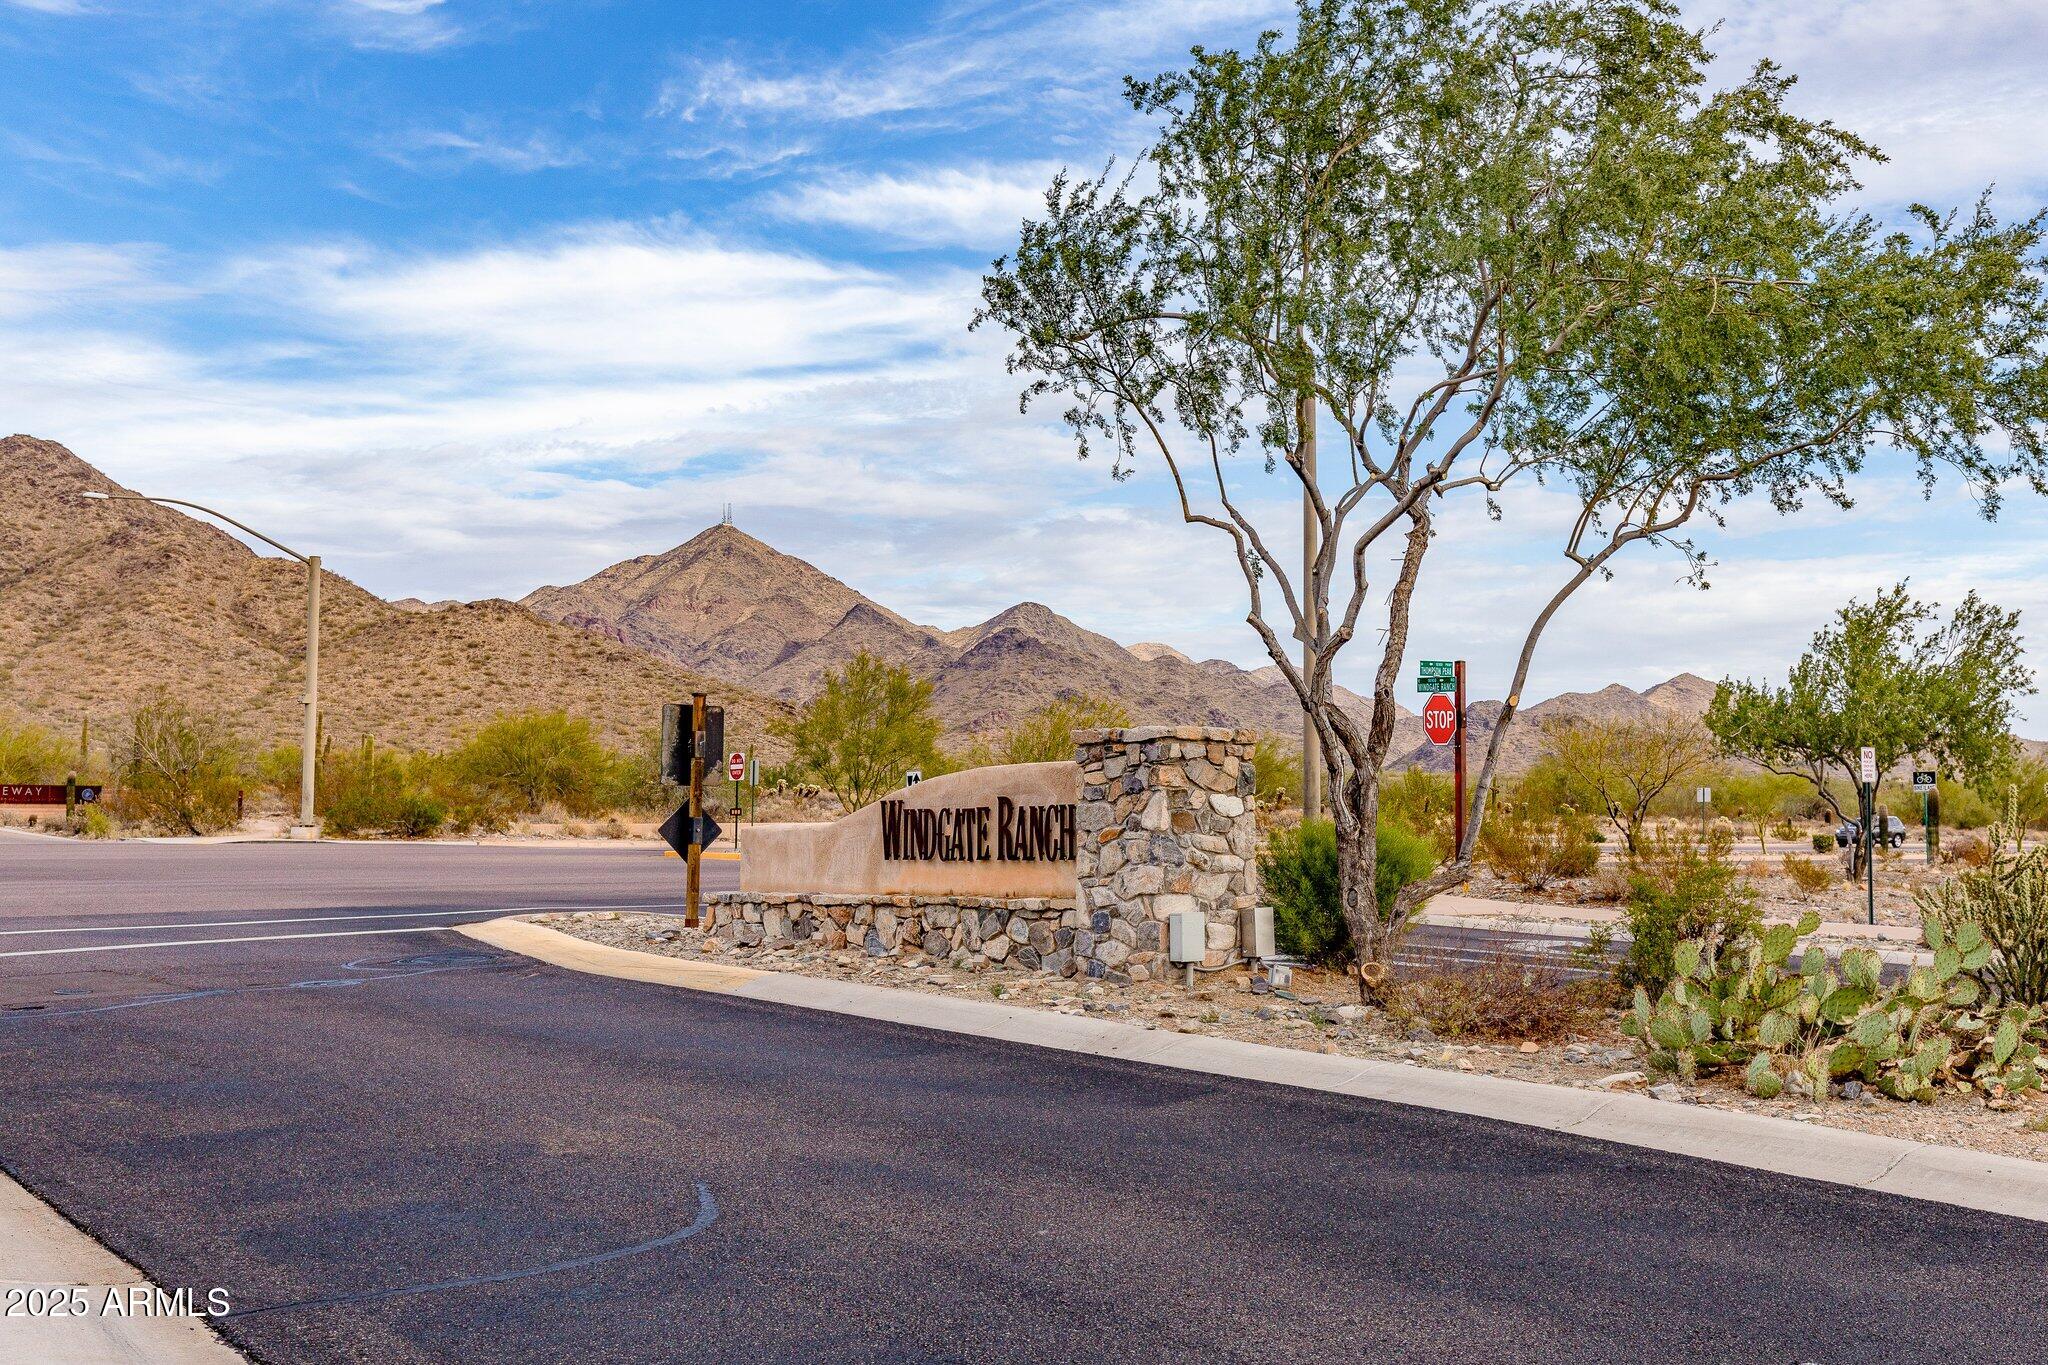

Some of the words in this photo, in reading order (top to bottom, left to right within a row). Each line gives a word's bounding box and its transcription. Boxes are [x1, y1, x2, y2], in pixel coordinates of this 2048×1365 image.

[1420, 666, 1441, 675] THOMPSON
[1442, 666, 1452, 675] PEAK
[1418, 682, 1439, 691] WINDGATE
[1440, 682, 1456, 691] RANCH
[1426, 710, 1454, 729] STOP
[1863, 750, 1873, 759] NO
[880, 799, 991, 862] WINDGATE
[996, 796, 1077, 862] RANCH
